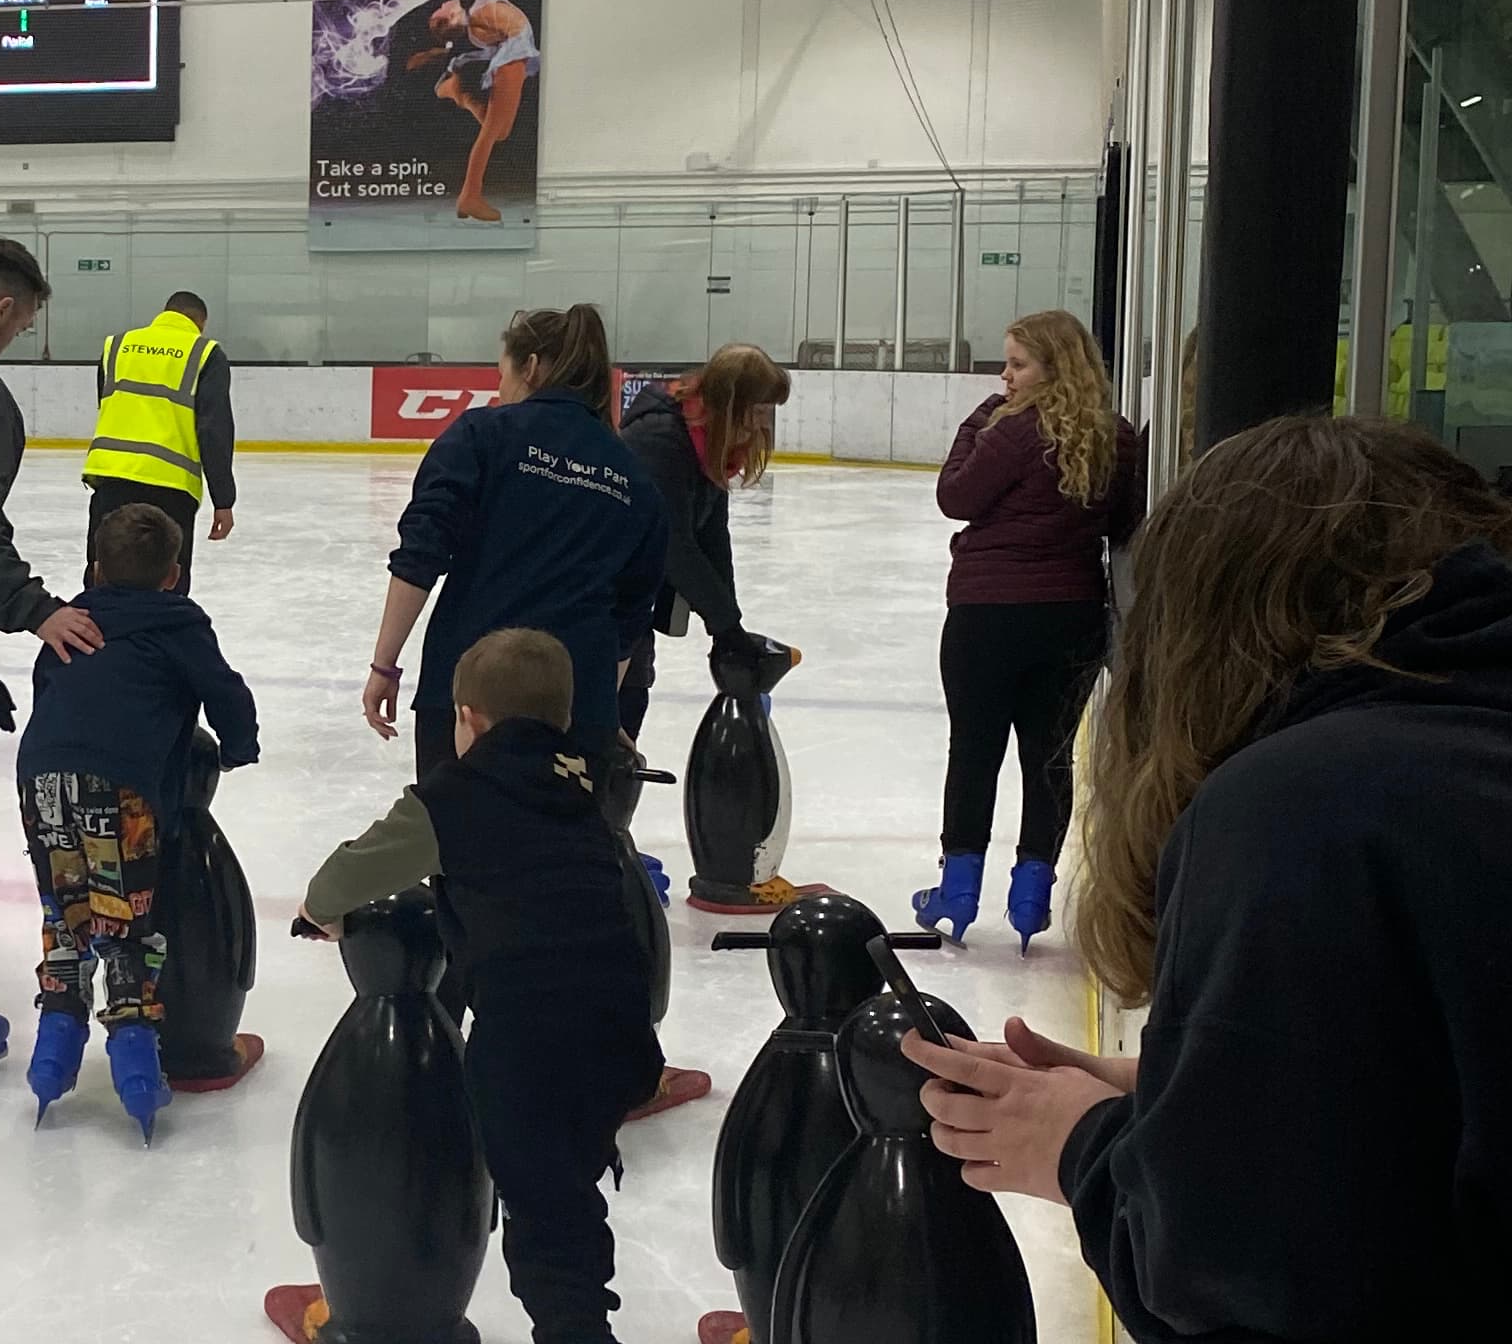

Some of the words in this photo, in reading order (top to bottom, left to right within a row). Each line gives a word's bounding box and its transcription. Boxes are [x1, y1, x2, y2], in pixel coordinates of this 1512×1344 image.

[316, 159, 365, 177] Take
[371, 163, 383, 176] a
[316, 180, 351, 197] Cut
[358, 182, 411, 197] some
[121, 343, 184, 359] STEWARD
[623, 380, 650, 395] SU
[528, 445, 559, 468] Play
[565, 457, 598, 476] Your
[603, 466, 629, 488] Part
